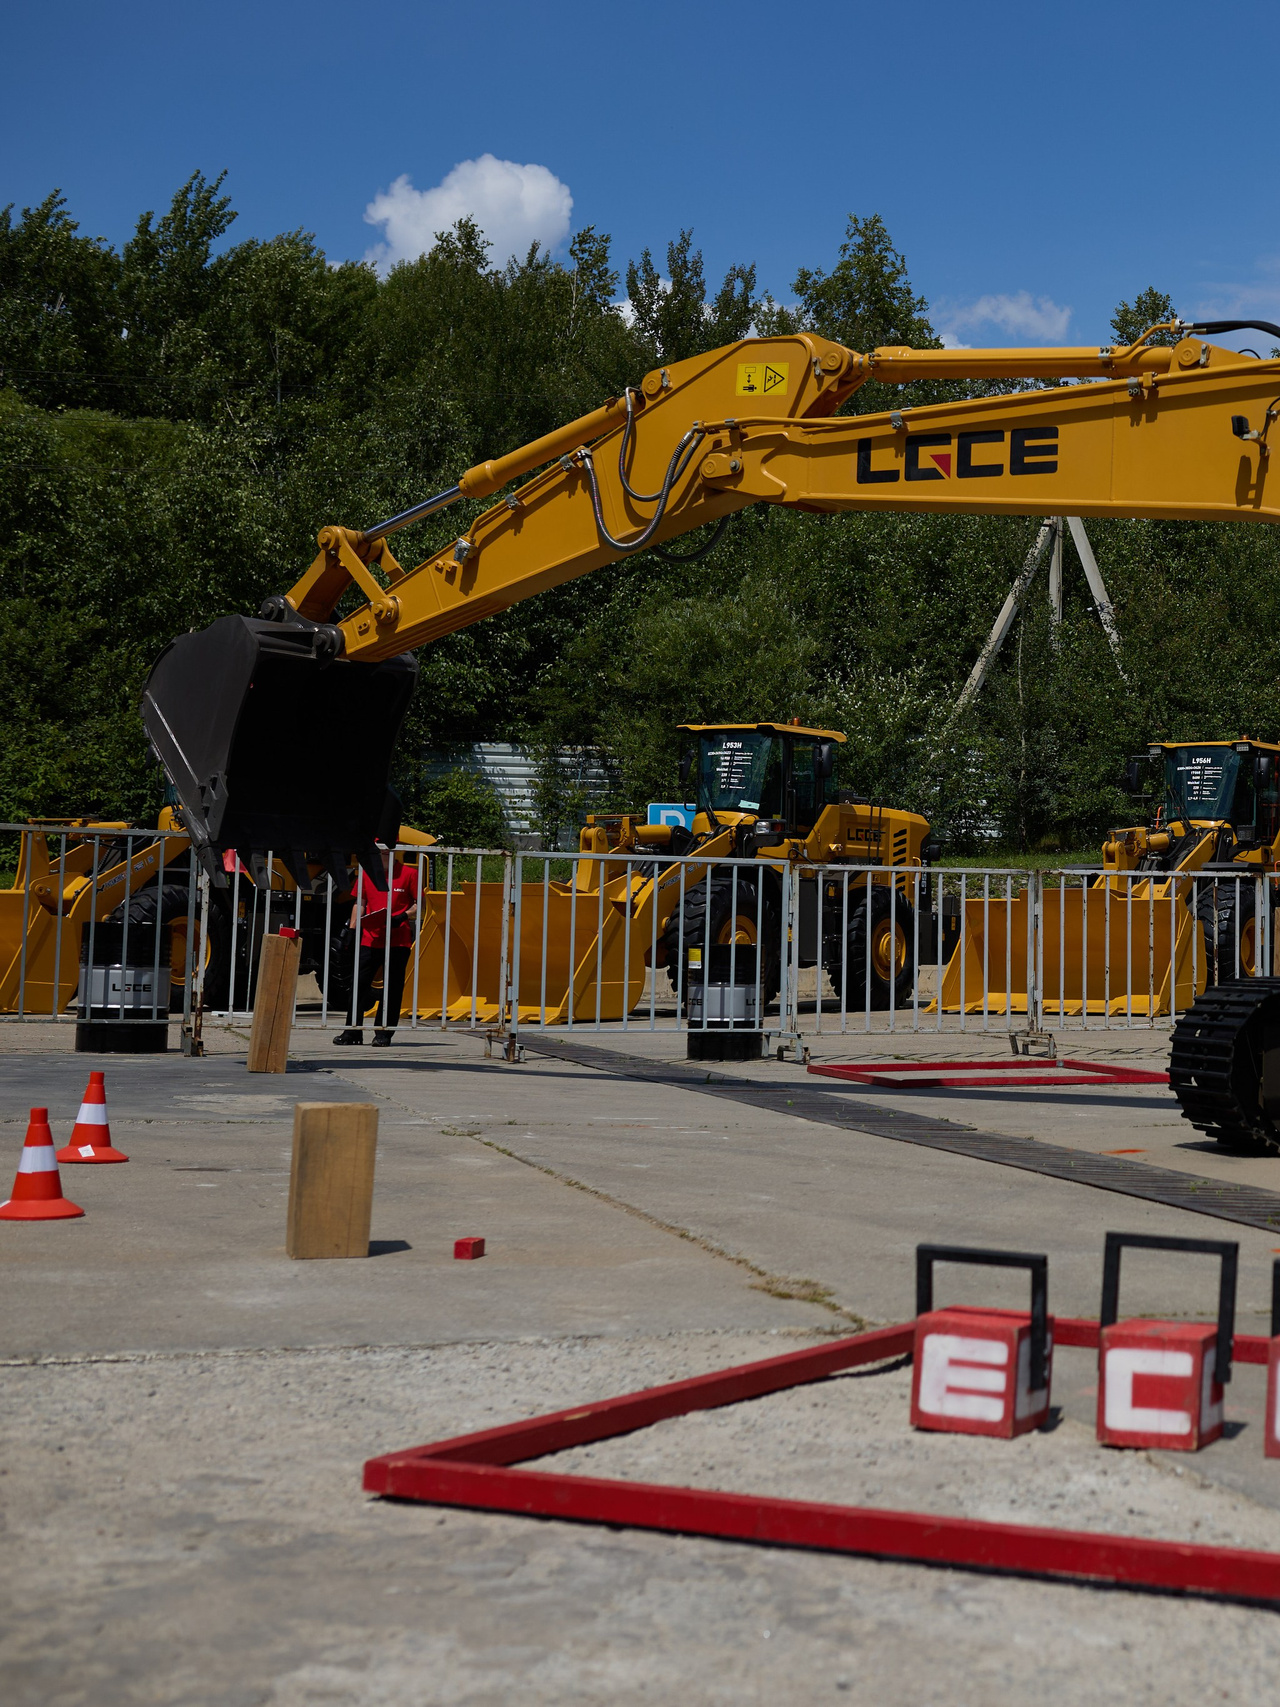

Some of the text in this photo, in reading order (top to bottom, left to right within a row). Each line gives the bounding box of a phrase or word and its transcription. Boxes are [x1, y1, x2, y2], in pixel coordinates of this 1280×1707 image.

[856, 426, 1059, 485] LGCE
[919, 1332, 1009, 1422] E
[1104, 1347, 1194, 1436] C
